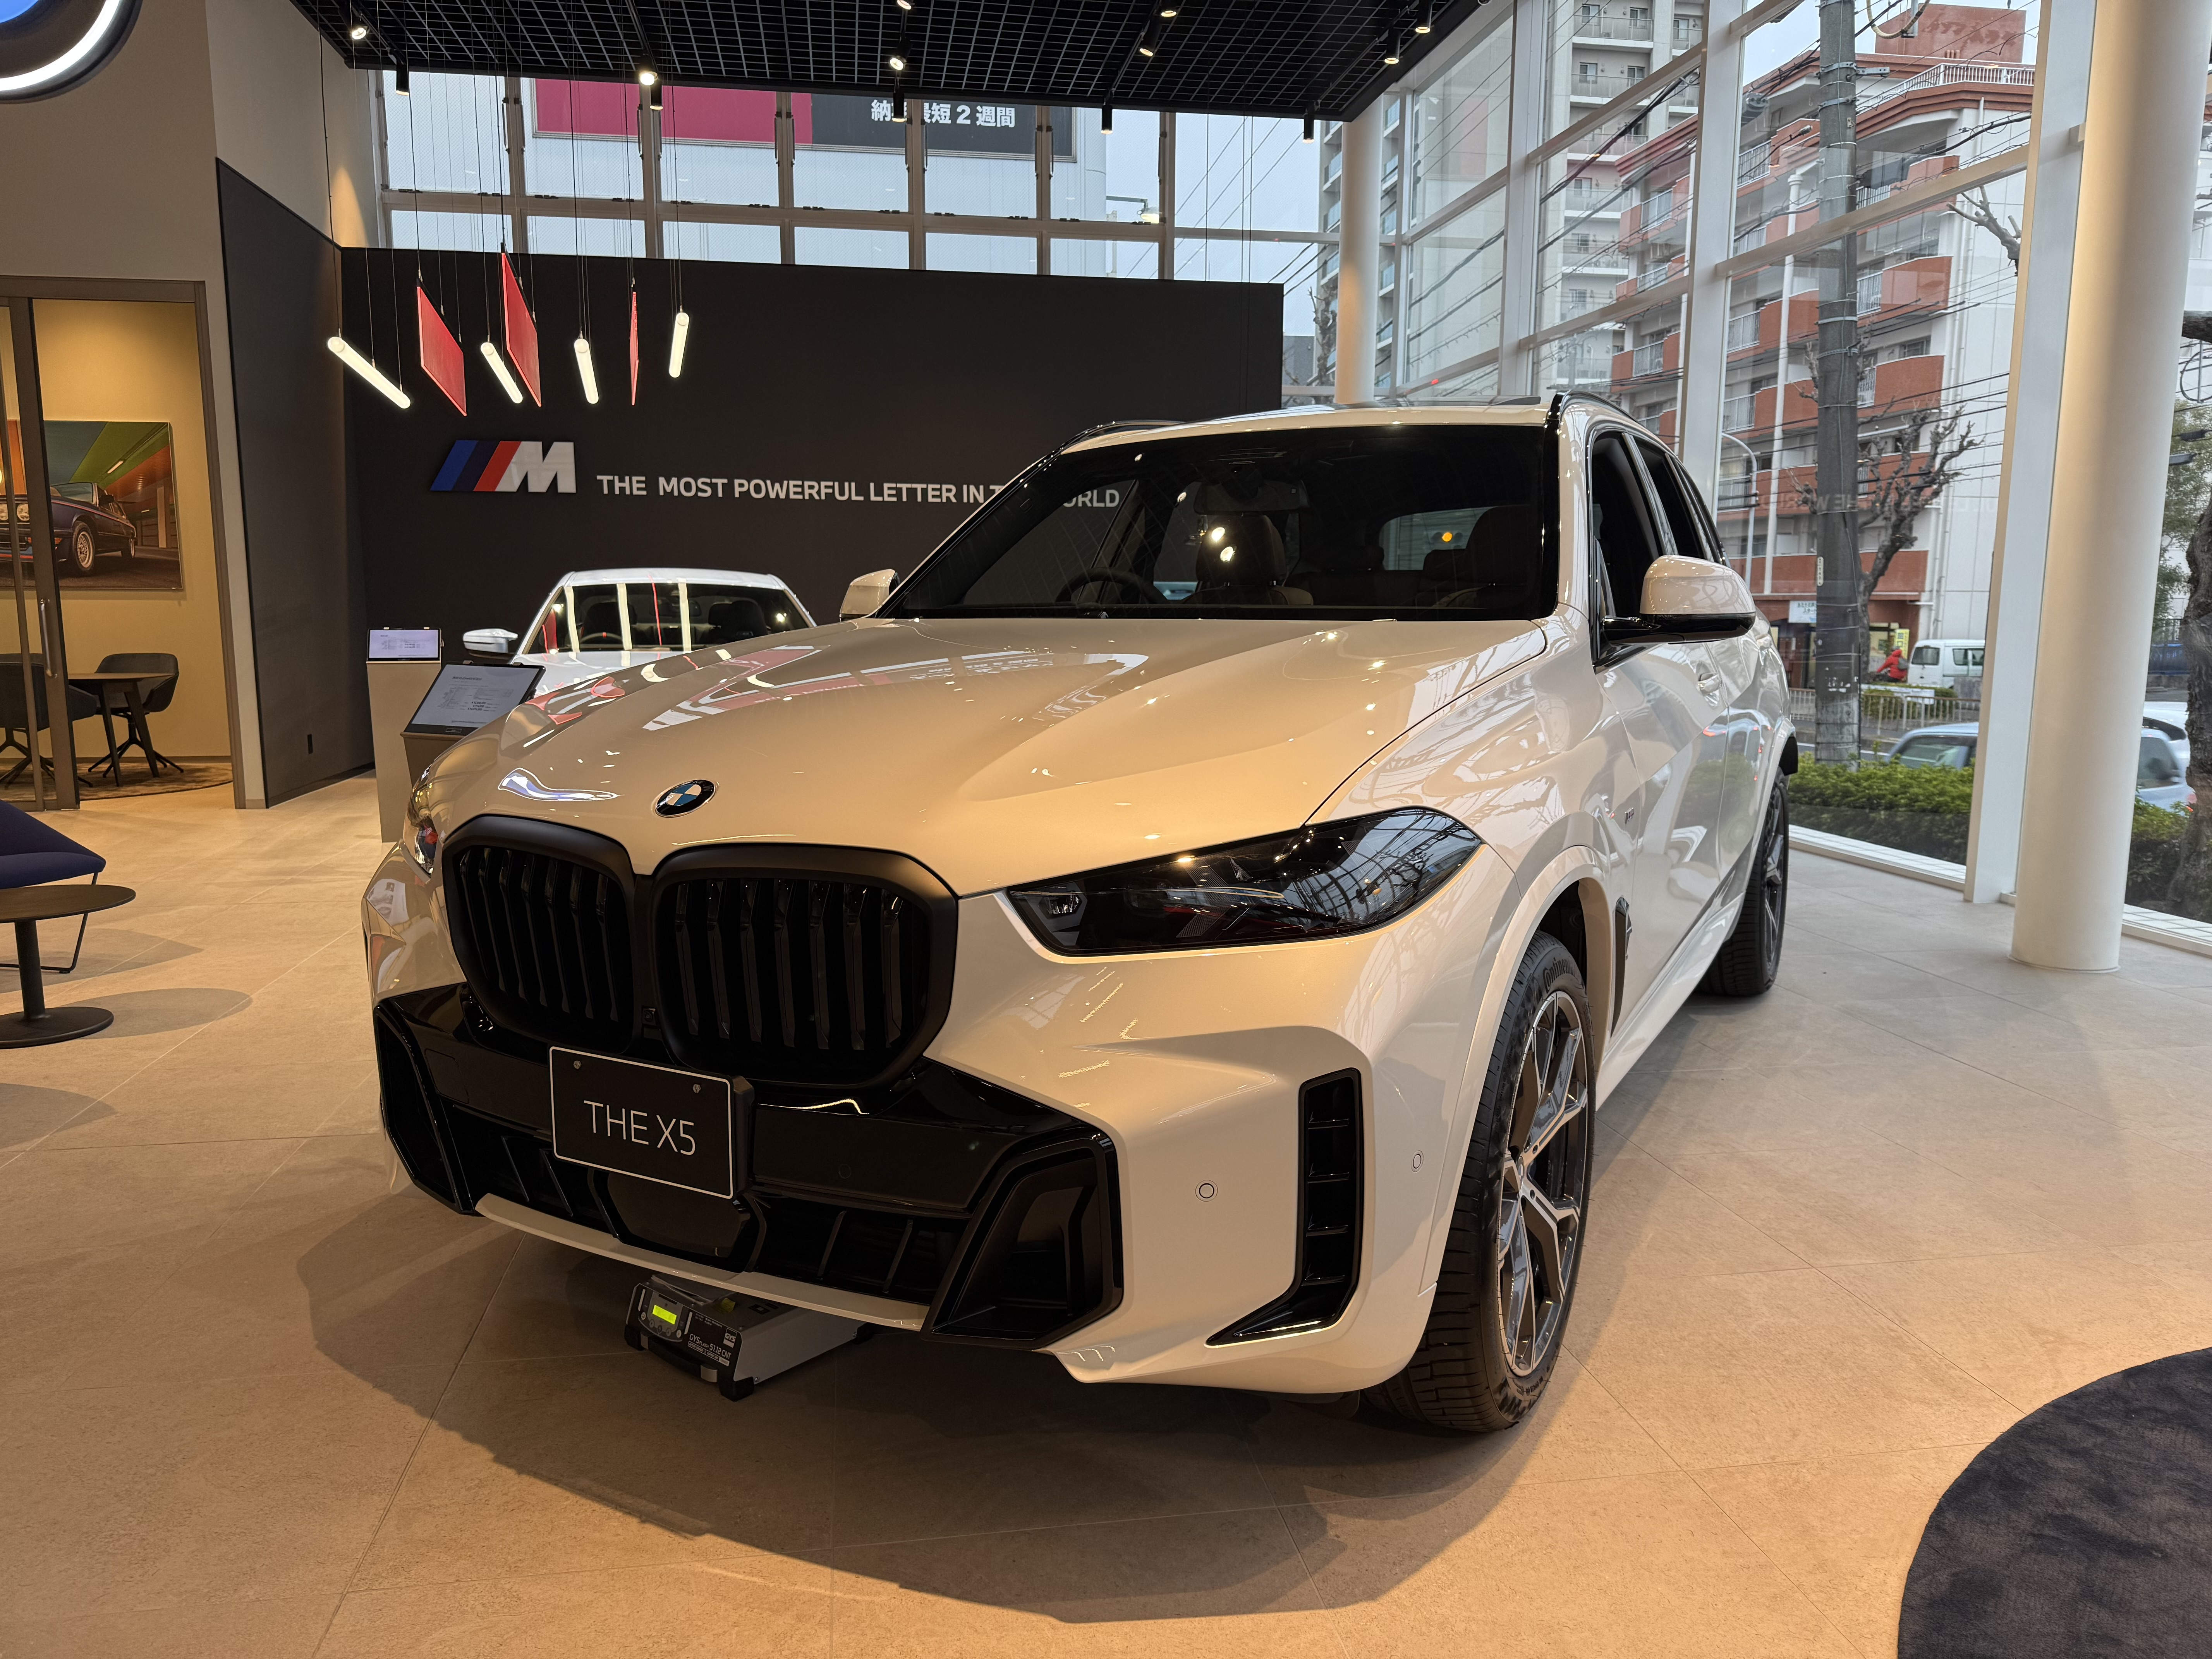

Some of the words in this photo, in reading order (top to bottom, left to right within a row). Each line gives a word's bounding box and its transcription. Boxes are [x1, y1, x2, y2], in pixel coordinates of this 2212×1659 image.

[597, 475, 647, 495] THE
[658, 477, 728, 498] MOST
[734, 479, 864, 501] POWERFUL
[869, 482, 957, 503] LETTER
[963, 484, 984, 503] IN
[584, 1100, 649, 1145] THE
[656, 1115, 696, 1156] X5
[725, 1333, 736, 1342] GYS
[709, 1343, 721, 1355] 51.12
[721, 1349, 732, 1359] CNT
